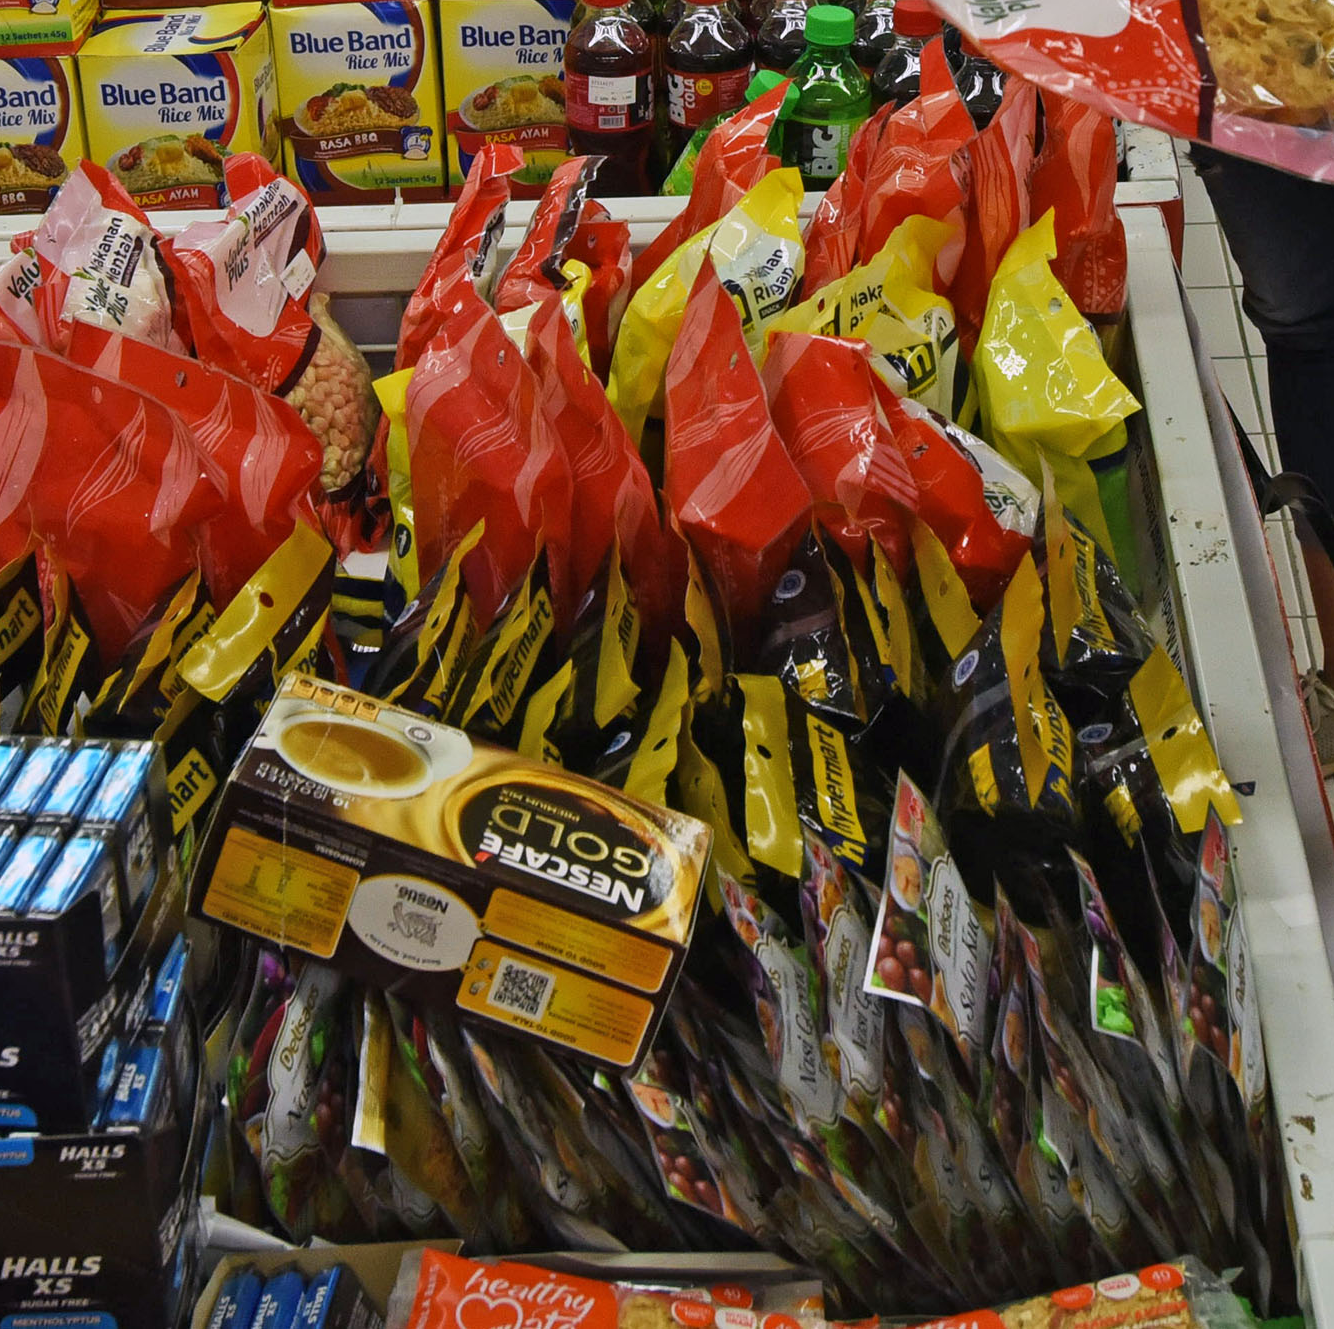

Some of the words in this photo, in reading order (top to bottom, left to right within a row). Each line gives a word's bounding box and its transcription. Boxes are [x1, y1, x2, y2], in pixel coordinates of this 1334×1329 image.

[290, 31, 344, 55] Blue
[347, 28, 412, 52] Band
[345, 53, 379, 71] Rice
[383, 52, 411, 68] Mix
[100, 83, 157, 107] Blue
[159, 79, 227, 104] Band
[667, 73, 686, 125] BIG
[684, 77, 696, 110] COLA
[27, 109, 57, 126] Mix
[319, 136, 353, 151] RASA
[354, 131, 379, 146] BBQ
[811, 124, 841, 176] BIG
[252, 193, 291, 238] Mentah
[89, 216, 124, 273] Makanan
[107, 232, 134, 285] Mentah
[107, 292, 129, 326] Plus
[489, 598, 552, 718] hypermart
[819, 722, 857, 835] hypermart
[491, 803, 651, 878] GOLD
[59, 1142, 126, 1163] HALLS
[0, 1255, 102, 1279] HALLS
[33, 1275, 73, 1295] XS
[463, 1266, 597, 1320] healthy
